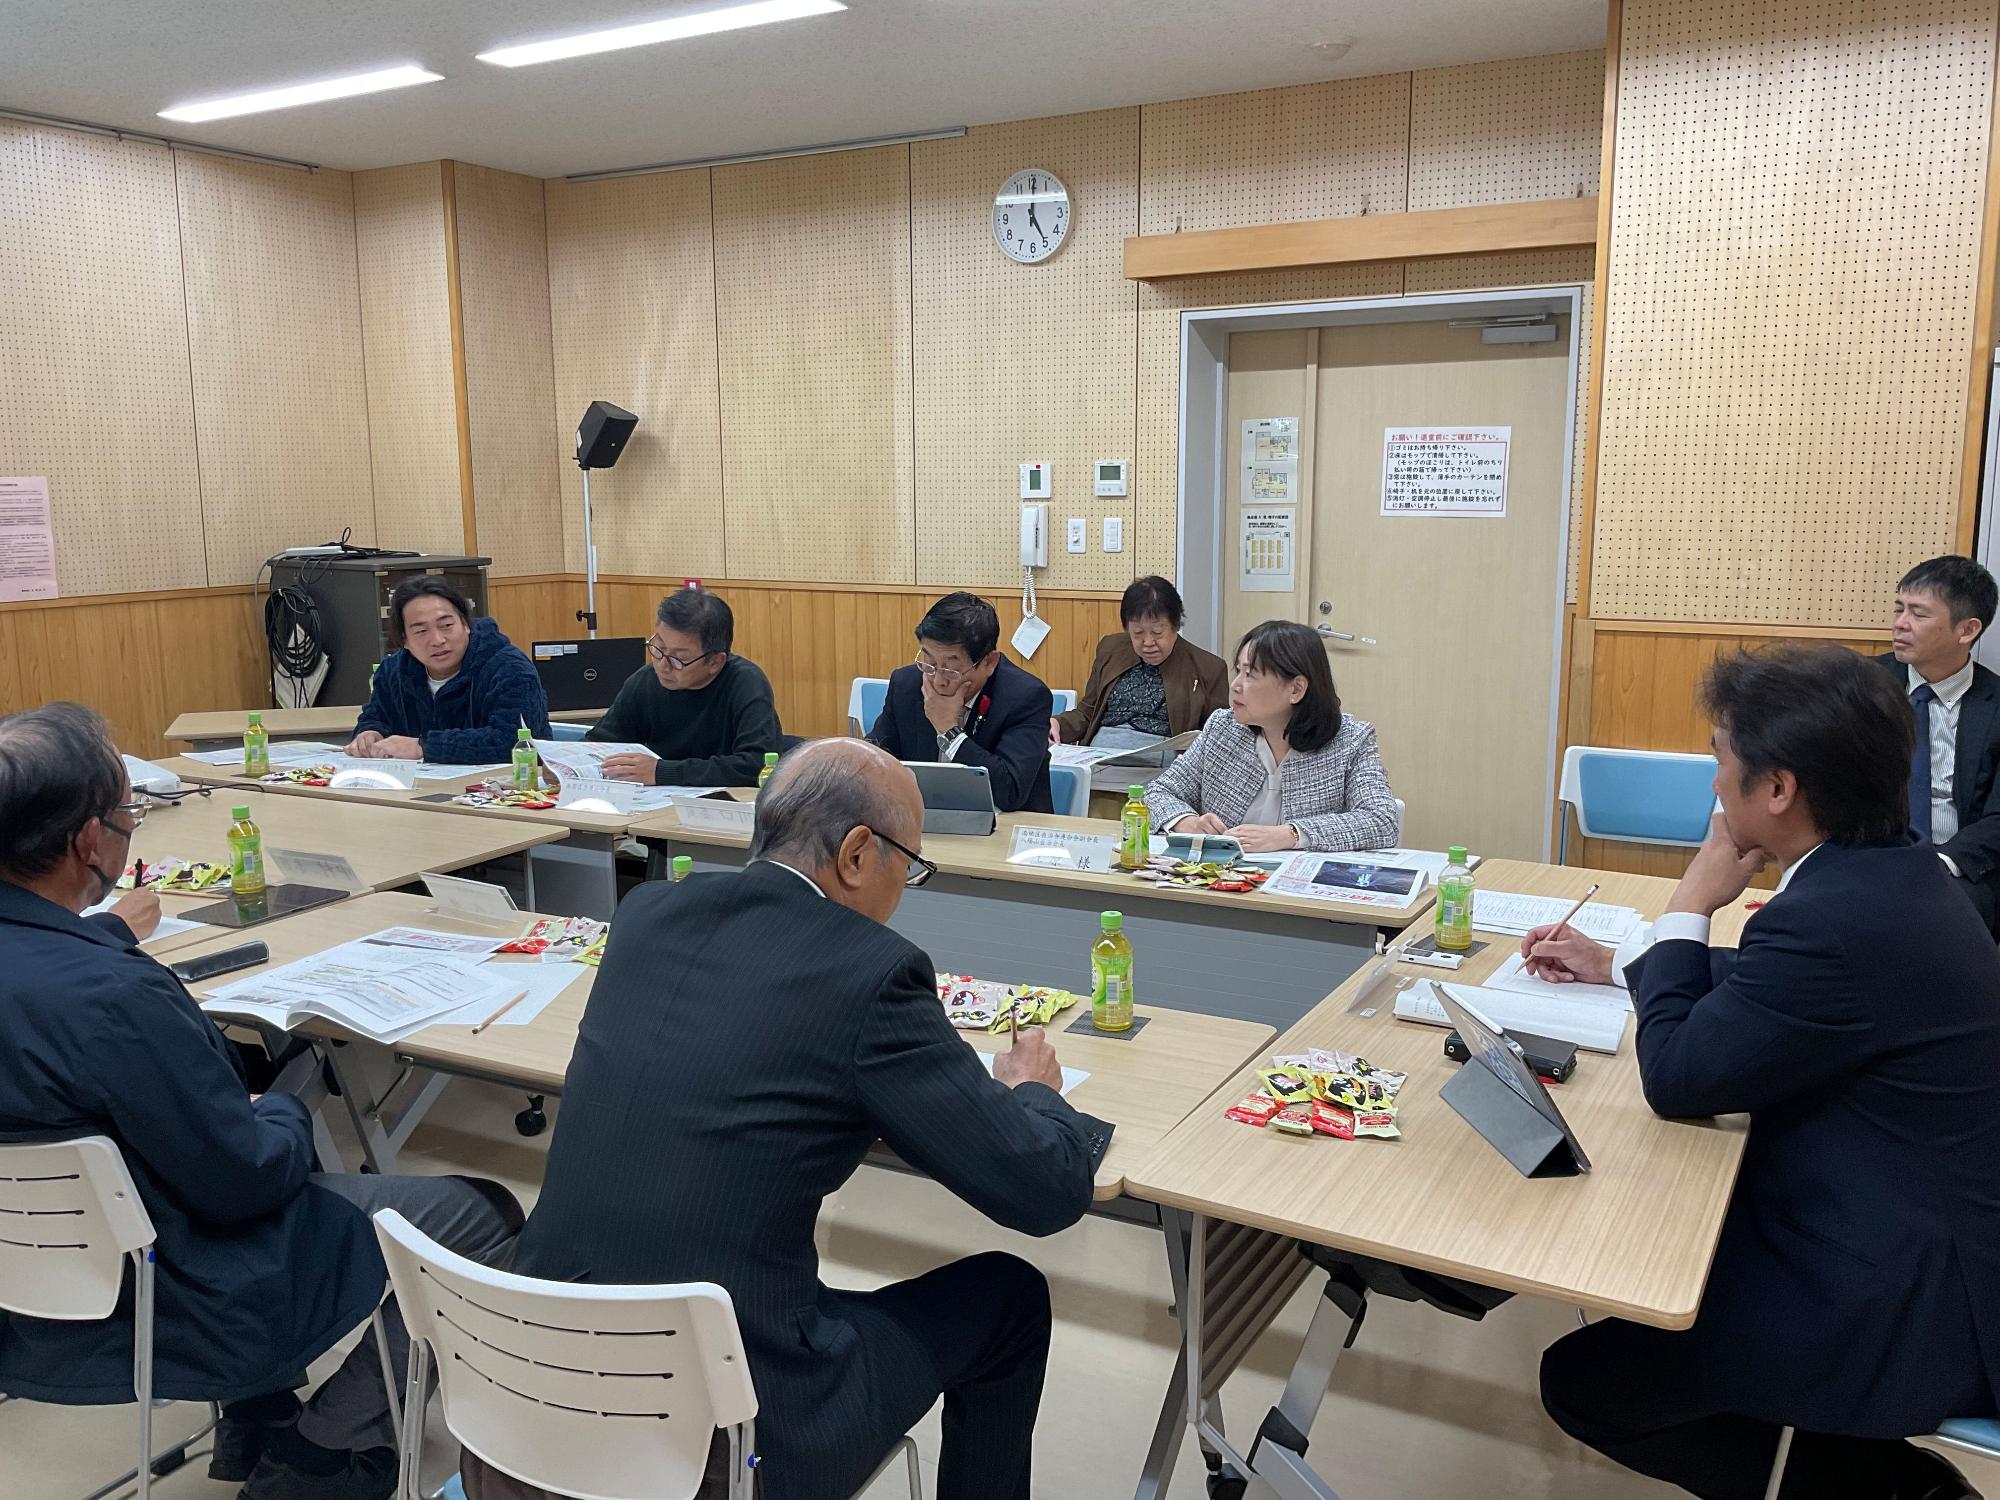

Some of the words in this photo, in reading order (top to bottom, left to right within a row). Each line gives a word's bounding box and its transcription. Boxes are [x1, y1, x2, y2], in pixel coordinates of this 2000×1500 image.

[1016, 184, 1023, 195] 11
[1057, 207, 1064, 218] 3
[1002, 213, 1009, 225] 9
[1006, 229, 1013, 240] 8
[1052, 223, 1060, 235] 4
[1018, 240, 1024, 251] 7
[1030, 242, 1037, 253] 6
[1042, 237, 1049, 248] 5
